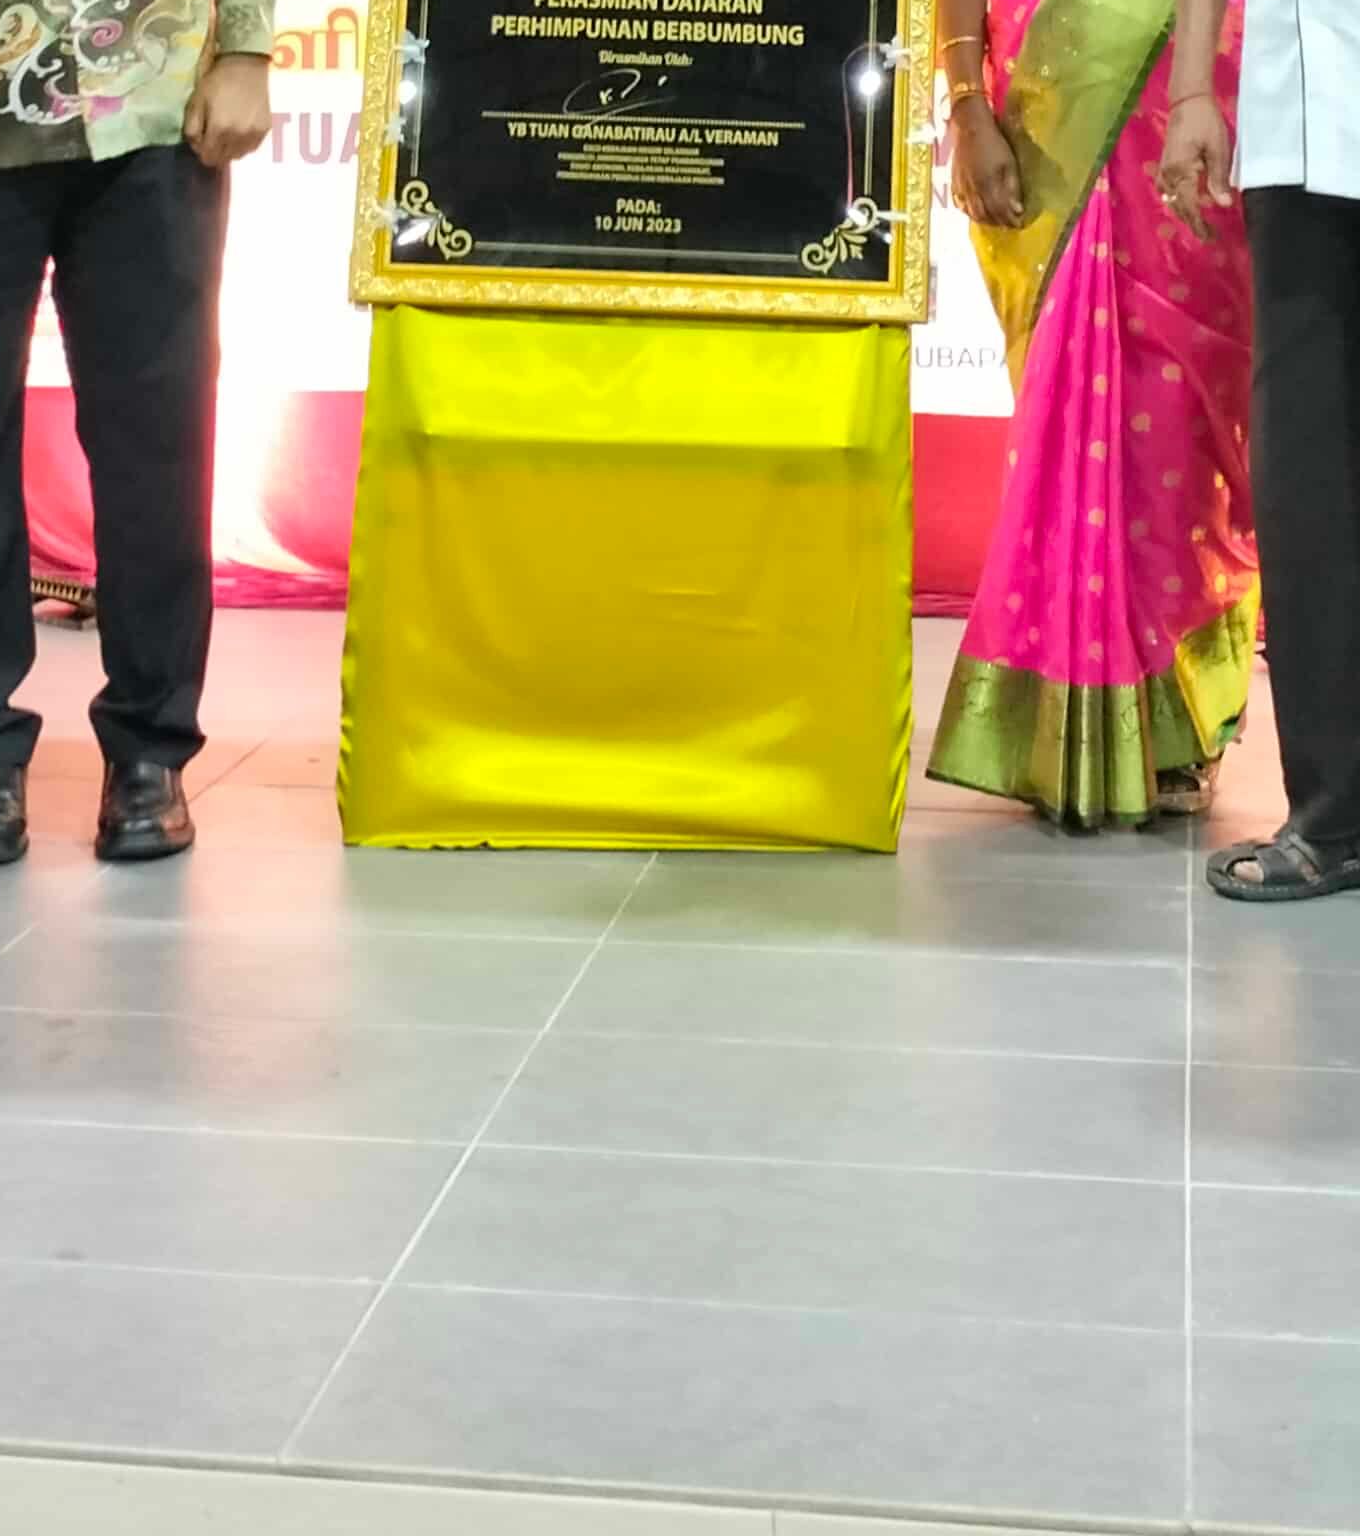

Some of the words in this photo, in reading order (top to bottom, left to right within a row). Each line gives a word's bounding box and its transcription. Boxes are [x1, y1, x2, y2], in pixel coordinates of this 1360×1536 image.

[491, 15, 649, 40] PERHIMPUNAN
[652, 20, 805, 46] BERBUMBUNG
[508, 121, 527, 137] YB
[529, 122, 569, 138] TUAN
[679, 129, 702, 144] A/L
[704, 130, 779, 146] VERAMAN
[616, 198, 661, 214] PADA:
[595, 215, 612, 231] 10
[614, 216, 643, 232] JUN
[646, 217, 682, 233] 2023
